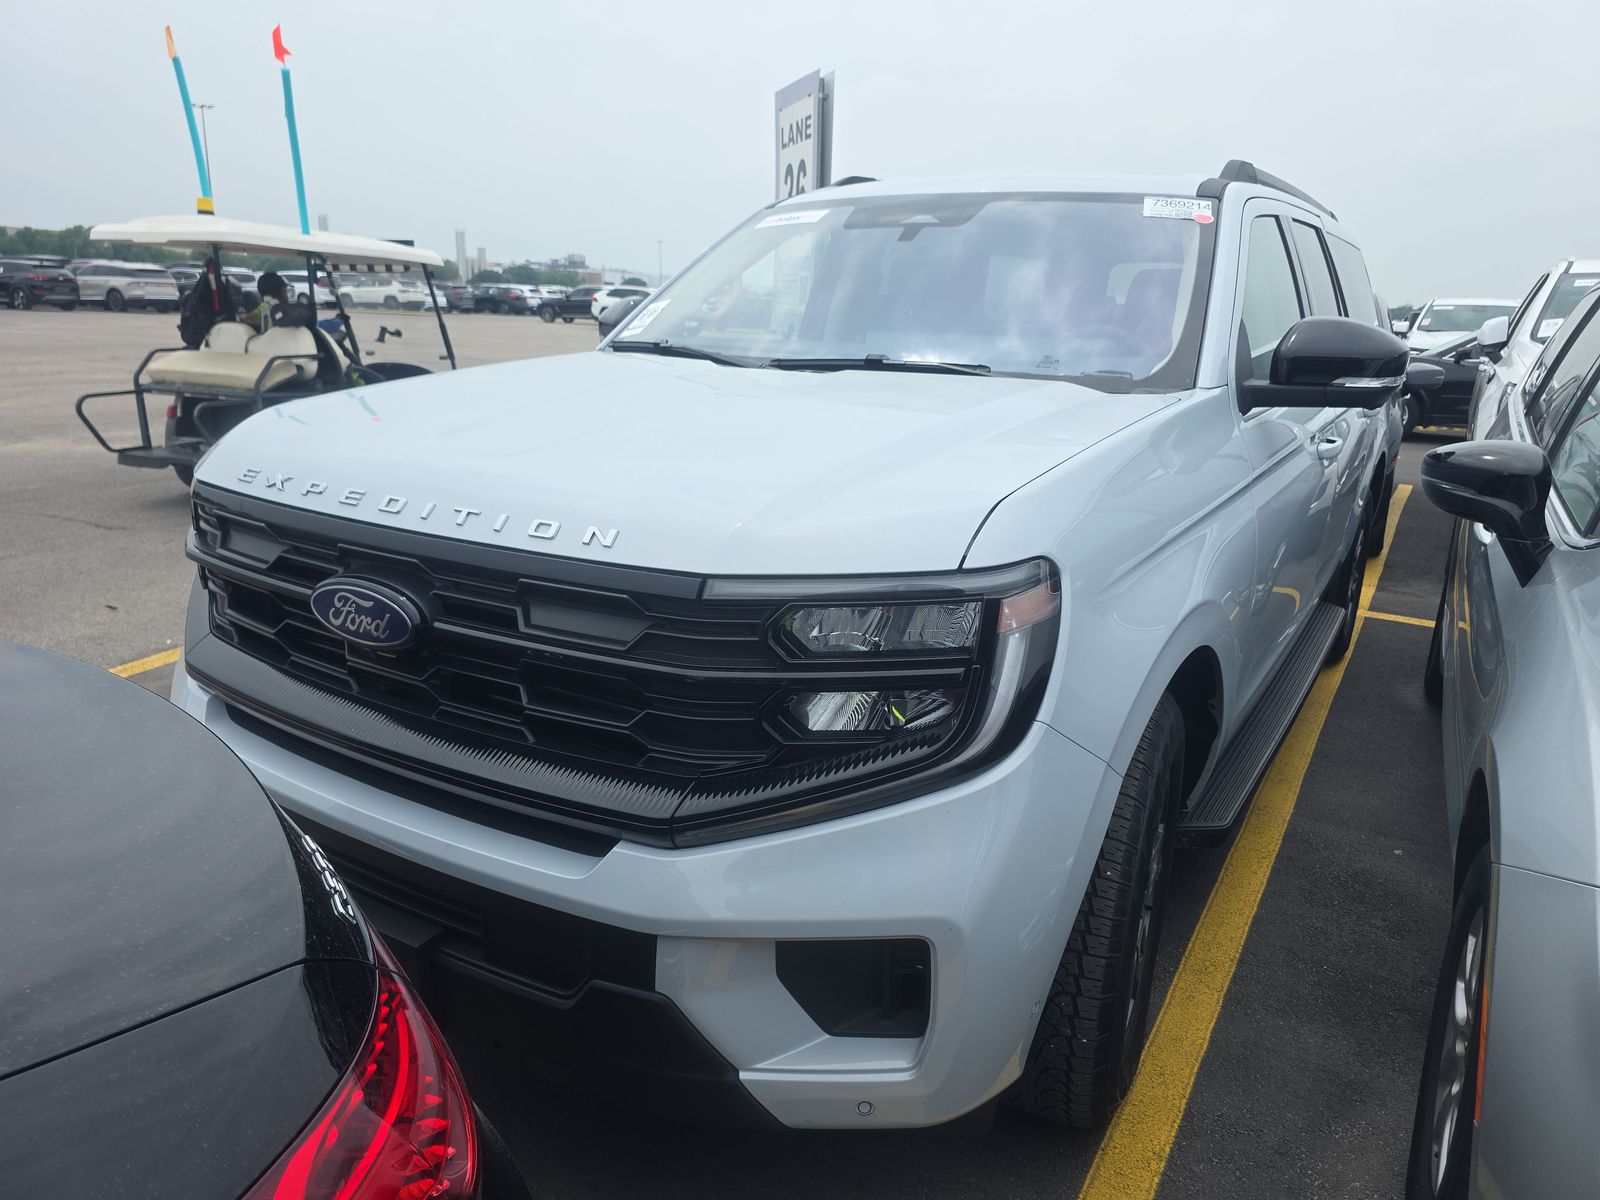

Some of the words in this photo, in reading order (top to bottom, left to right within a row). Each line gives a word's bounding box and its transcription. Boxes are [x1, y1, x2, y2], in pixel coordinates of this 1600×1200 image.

[781, 114, 812, 149] LANE
[1152, 199, 1211, 211] 7369214
[237, 468, 620, 549] EXPEDITION
[329, 592, 390, 639] Ford
